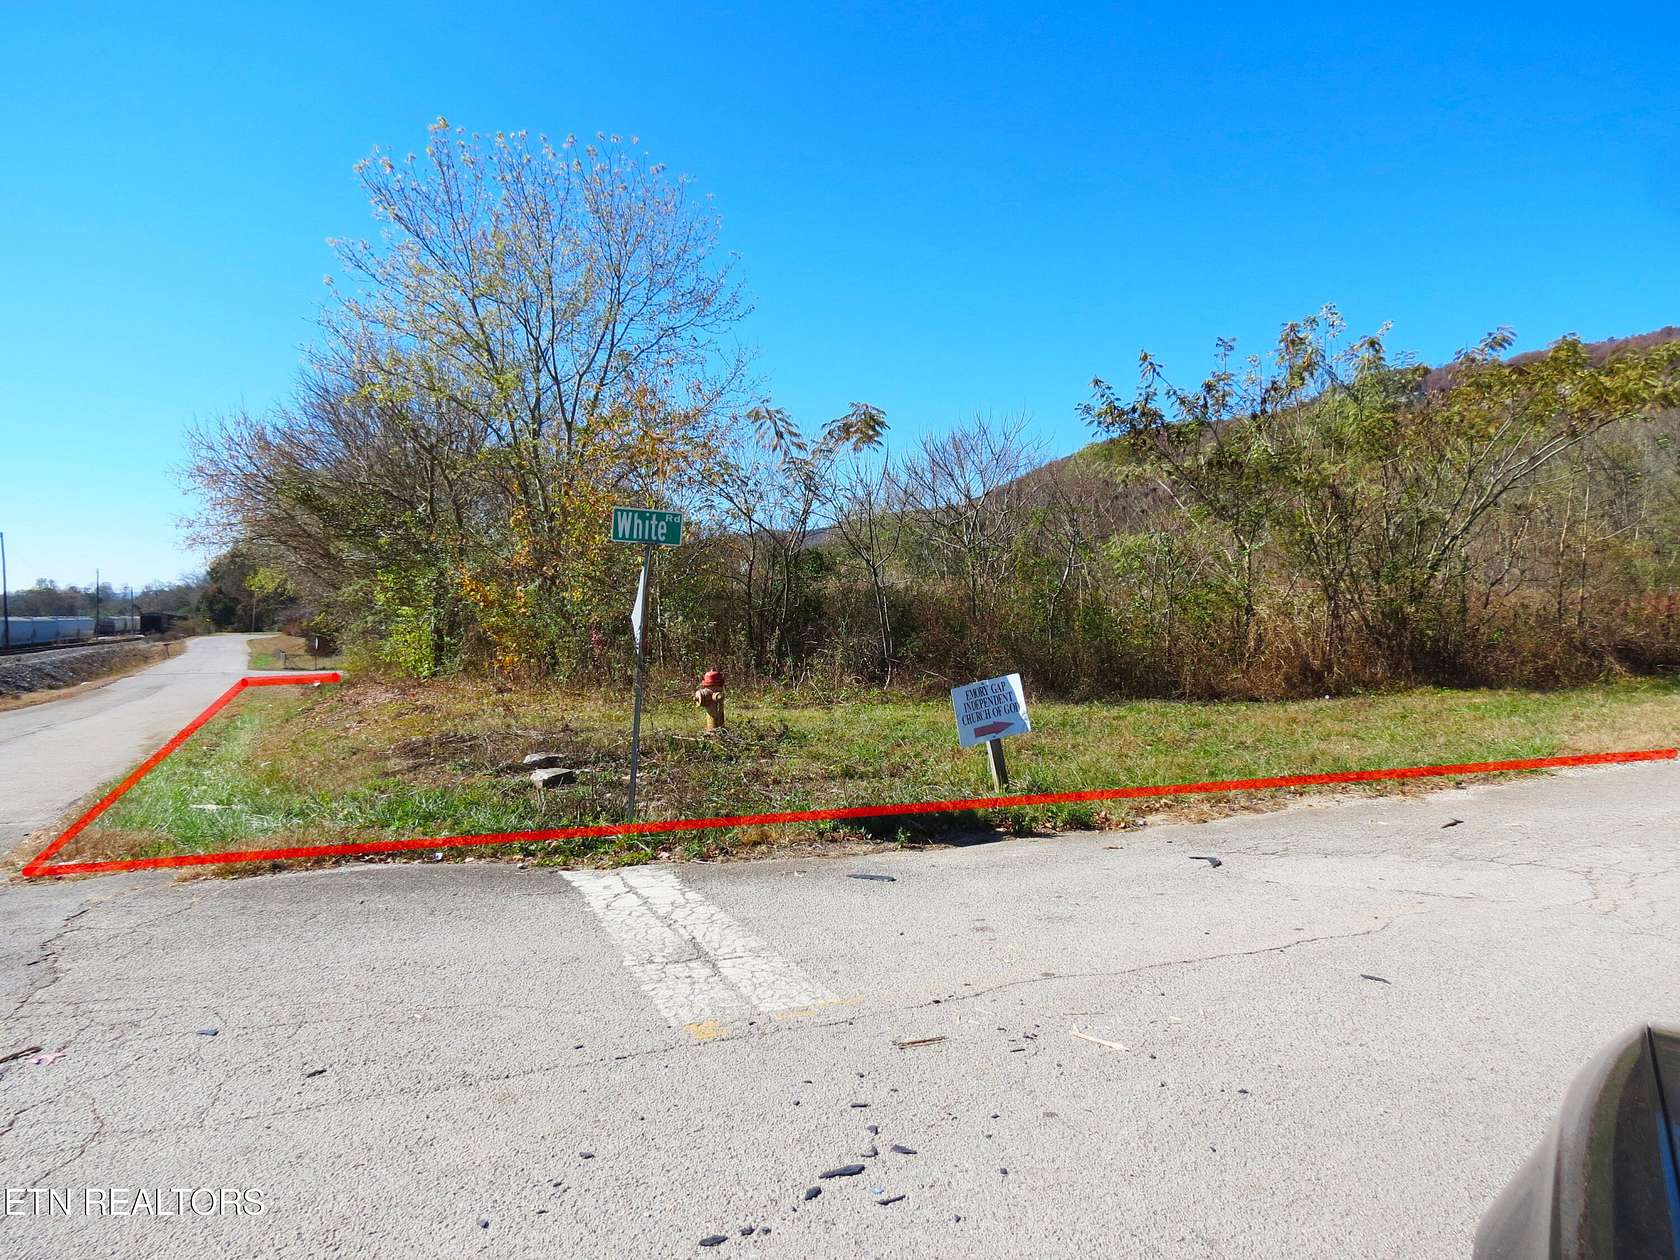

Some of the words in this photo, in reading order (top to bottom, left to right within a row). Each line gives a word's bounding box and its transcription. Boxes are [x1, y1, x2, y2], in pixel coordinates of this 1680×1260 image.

[617, 511, 667, 541] White
[665, 514, 680, 523] Rd
[963, 691, 1013, 713] INDEPENDENT
[965, 685, 989, 700] EMORY
[991, 681, 1006, 694] GAP
[962, 709, 991, 726] CHURCH
[992, 706, 1003, 717] OF
[1003, 702, 1020, 715] GOD
